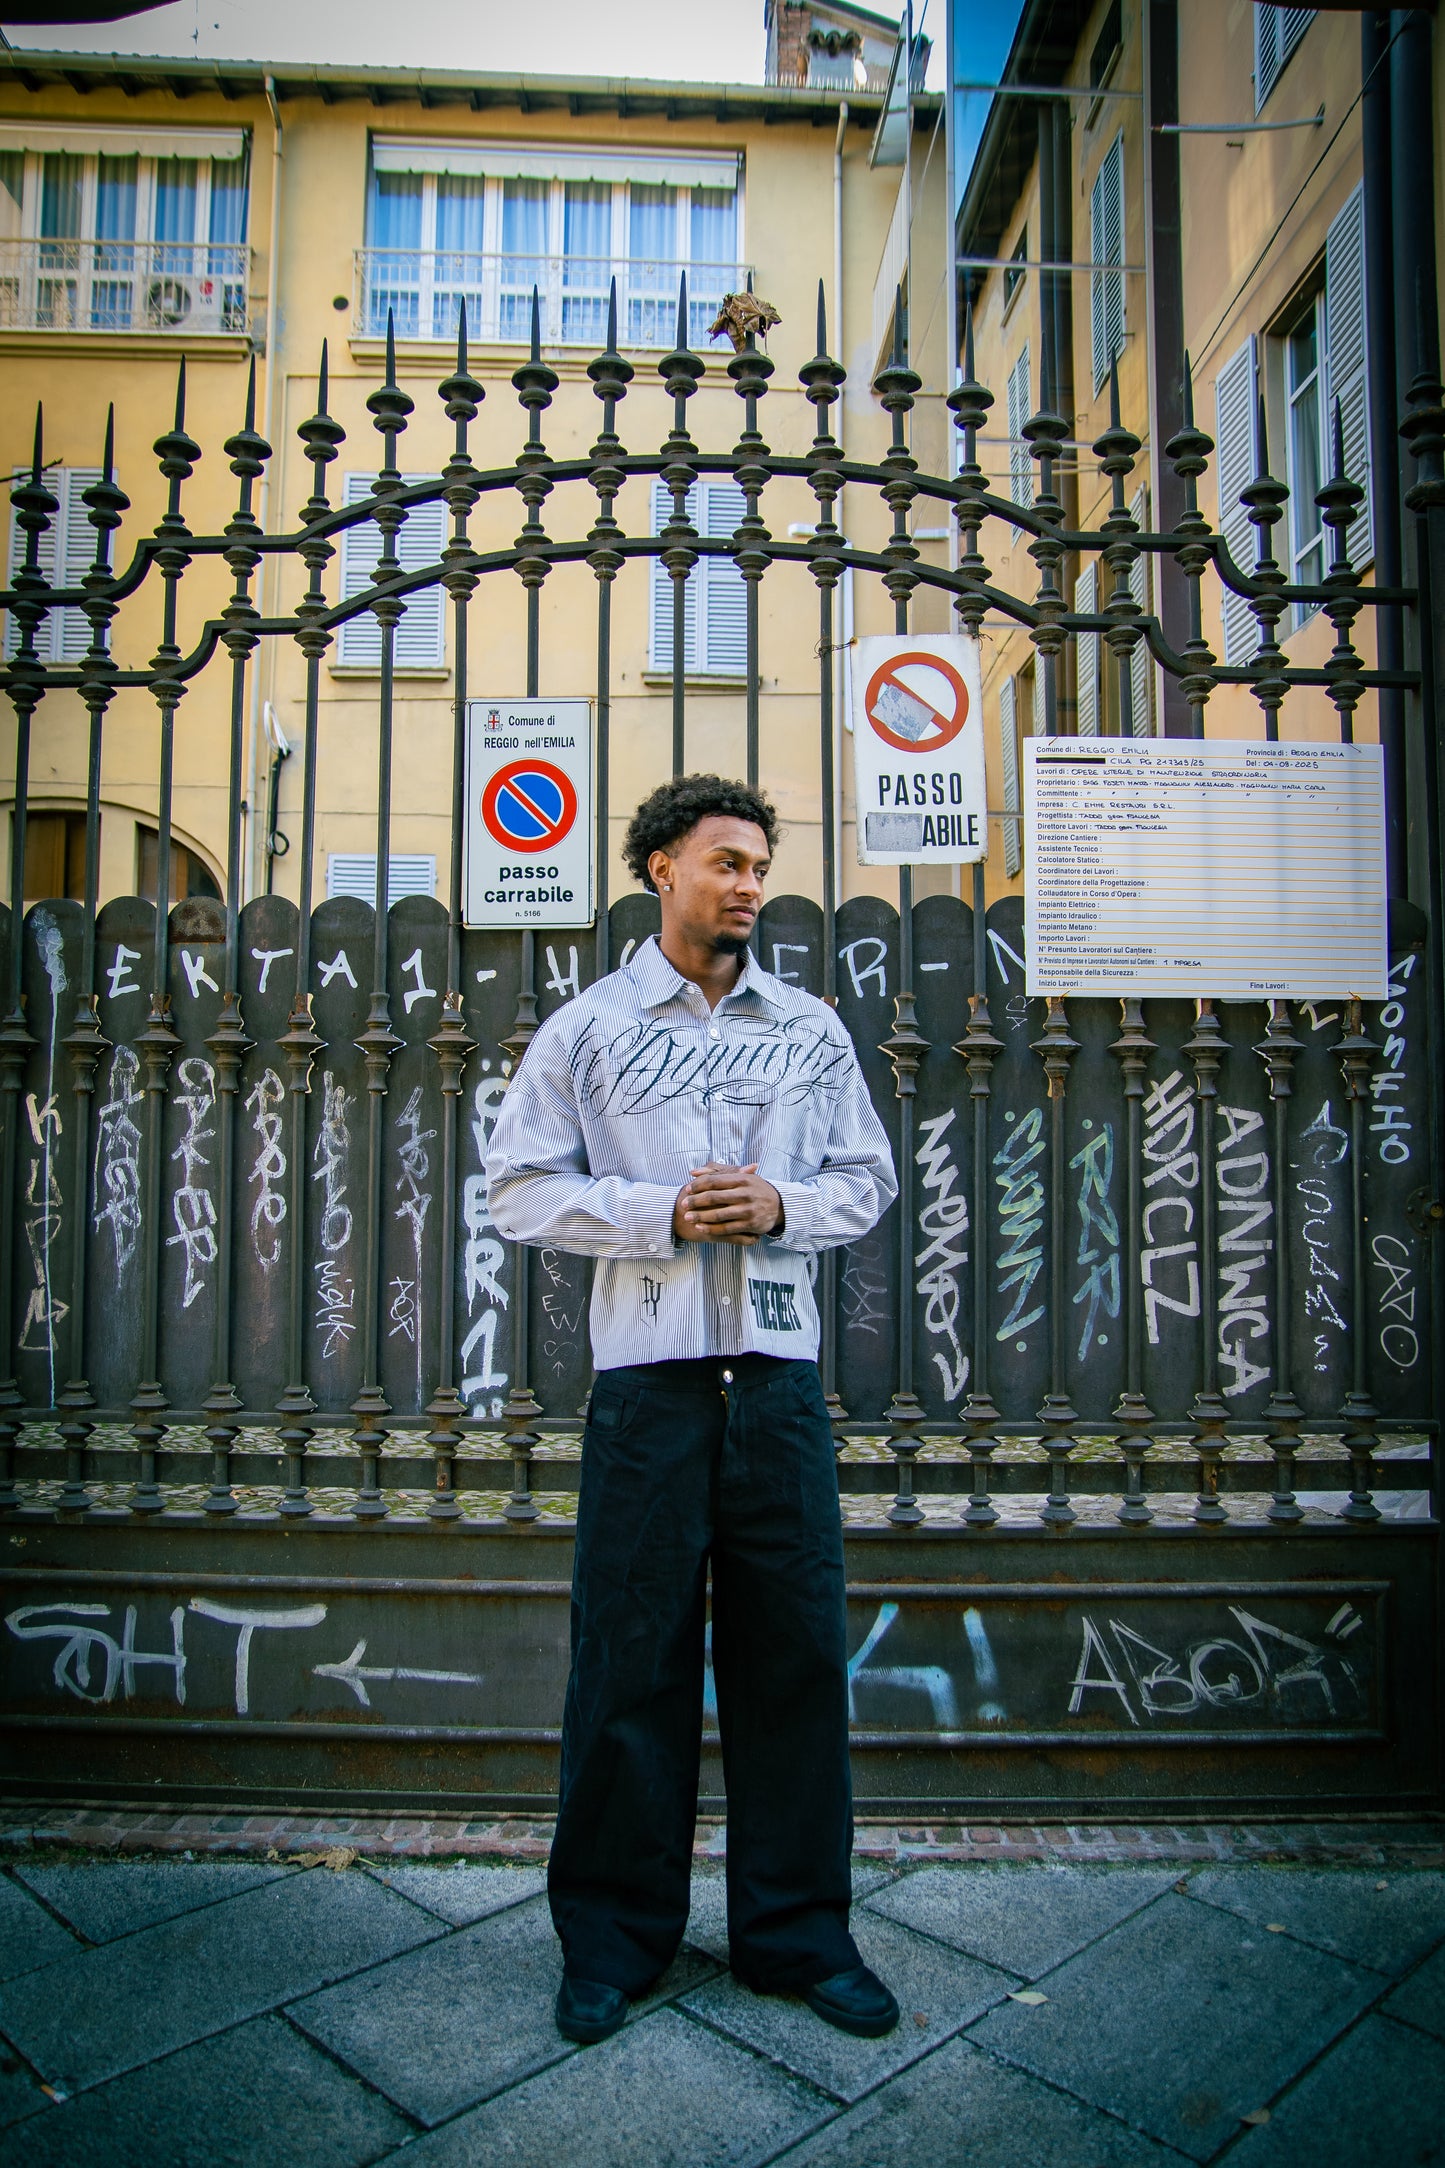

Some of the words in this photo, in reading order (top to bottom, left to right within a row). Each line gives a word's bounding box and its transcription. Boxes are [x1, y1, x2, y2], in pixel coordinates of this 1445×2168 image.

[509, 716, 544, 726] Comune
[547, 715, 555, 725] di
[485, 738, 519, 748] REGGIO
[525, 737, 575, 748] nell'EMILIA
[1246, 749, 1277, 757] Provincia
[879, 773, 962, 806] PASSO
[1036, 789, 1079, 797] Committente
[1037, 801, 1064, 809] Impresa
[1037, 812, 1073, 820] Progettista
[1037, 833, 1069, 841] Direzione
[1073, 845, 1099, 853] Tecnico
[1037, 856, 1076, 864] Calcolatore
[1076, 856, 1100, 864] Statico
[500, 866, 558, 882] passo
[1037, 867, 1081, 875] Coordinatore
[1037, 878, 1081, 886] Coordinatore
[1100, 880, 1145, 888] Progettazione
[484, 886, 573, 903] carrabile
[1038, 889, 1081, 897] Collaudatore
[1038, 901, 1067, 909] Impianto
[1038, 912, 1067, 920] Impianto
[1068, 912, 1098, 920] Idraulico
[1038, 923, 1068, 931] Impianto
[1068, 923, 1093, 931] Metano
[1038, 935, 1065, 943] Importo
[1066, 934, 1085, 942] Lavori
[1047, 945, 1078, 953] Presunto
[1078, 946, 1112, 954] Lavoratori
[1114, 946, 1123, 954] sul
[1124, 946, 1153, 954] Cantiere
[1038, 968, 1084, 976] Responsabile
[1102, 968, 1134, 976] Sicurezza
[1039, 979, 1056, 987] Inizio
[1059, 979, 1078, 987] Lavori
[1250, 981, 1264, 989] Fine
[1266, 982, 1285, 990] Lavori
